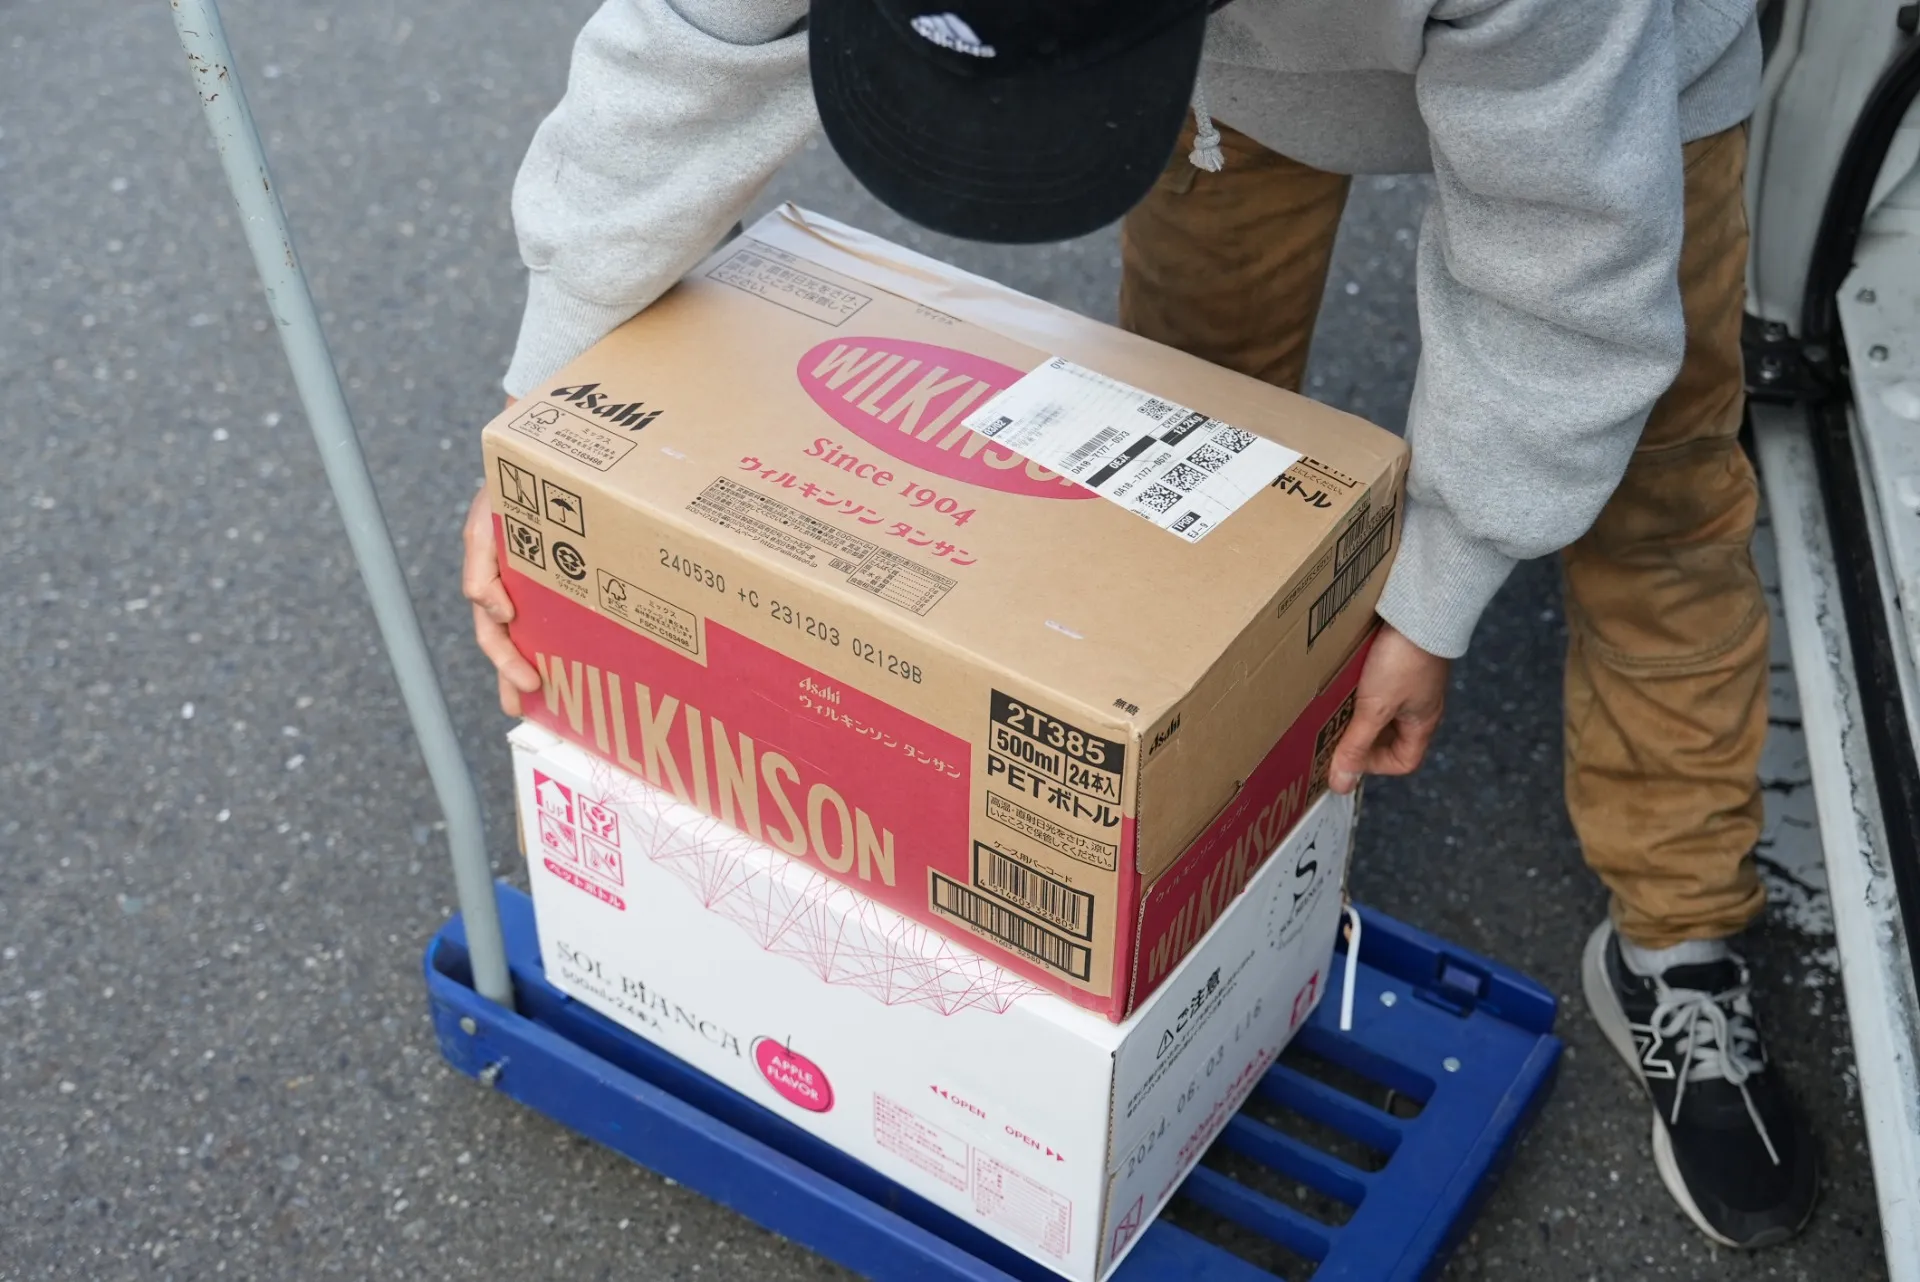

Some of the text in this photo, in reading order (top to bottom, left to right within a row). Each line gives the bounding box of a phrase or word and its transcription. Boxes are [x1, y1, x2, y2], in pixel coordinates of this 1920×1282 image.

[551, 383, 664, 431] Asahi
[739, 456, 885, 525] ウィルキンソン
[885, 522, 977, 566] タンサン
[803, 437, 976, 527] Since 1904
[660, 548, 726, 593] 240530
[771, 600, 840, 646] 231203
[852, 638, 922, 685] 02129B
[799, 676, 842, 705] Asahi
[799, 694, 962, 779] ウィルキンソン タンサン
[996, 731, 1116, 799] 500ml 24本入
[1006, 702, 1106, 764] 2T385
[1148, 711, 1182, 756] Asahi
[535, 651, 896, 887] WILKINSON
[987, 753, 1120, 828] PETボトル
[993, 839, 1073, 884] ケース用バーコード
[1148, 775, 1305, 983] WILKINSON
[1175, 966, 1222, 1033] ご注意
[766, 1065, 820, 1101] FLAVOR
[771, 1055, 813, 1085] APPLE
[950, 1095, 1040, 1150] OPEN OPEN
